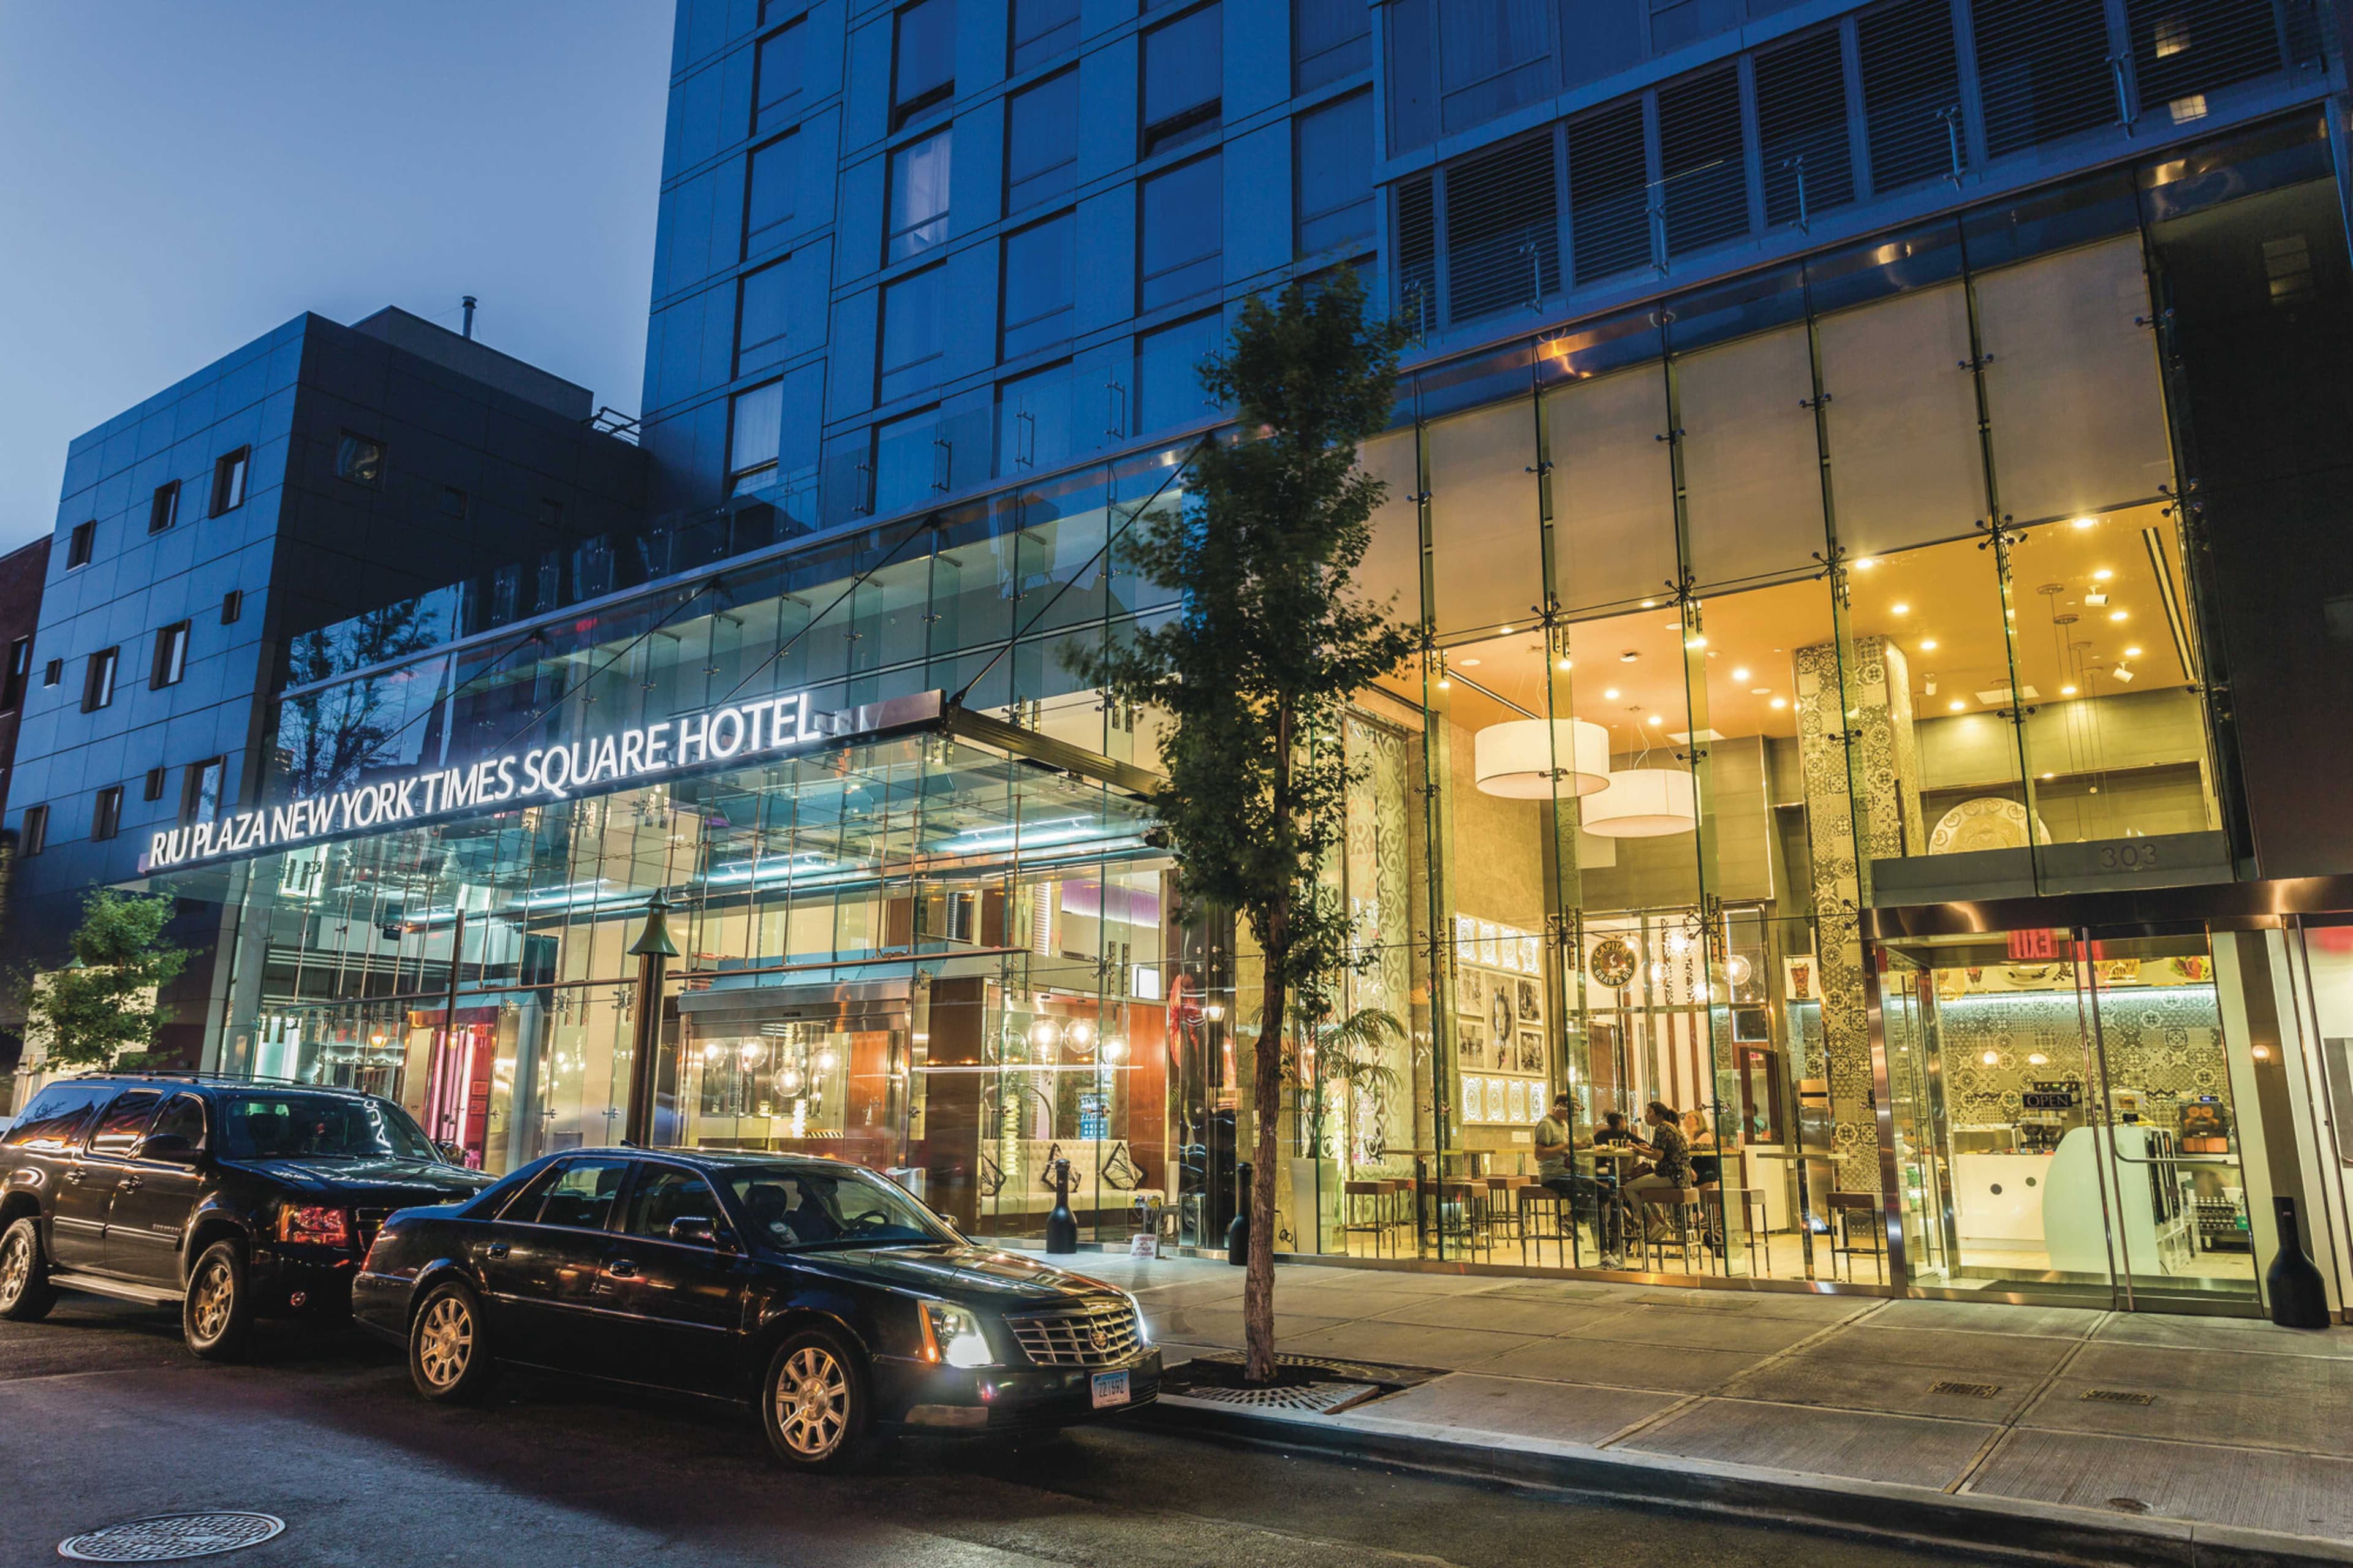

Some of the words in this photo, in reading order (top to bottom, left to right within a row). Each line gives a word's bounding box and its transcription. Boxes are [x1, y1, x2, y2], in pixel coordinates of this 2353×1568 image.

[149, 825, 190, 868] RIU
[190, 809, 265, 860] PLAZA
[270, 794, 339, 843] NEW
[341, 776, 418, 828] YORK
[420, 755, 515, 813] TIMES
[520, 722, 670, 797] SQUARE
[678, 693, 821, 765] HOTEL
[2101, 844, 2156, 868] 303
[1594, 942, 1631, 958] CAPITAL
[1594, 969, 1614, 985] GRAB
[2026, 1095, 2069, 1107] OPEN
